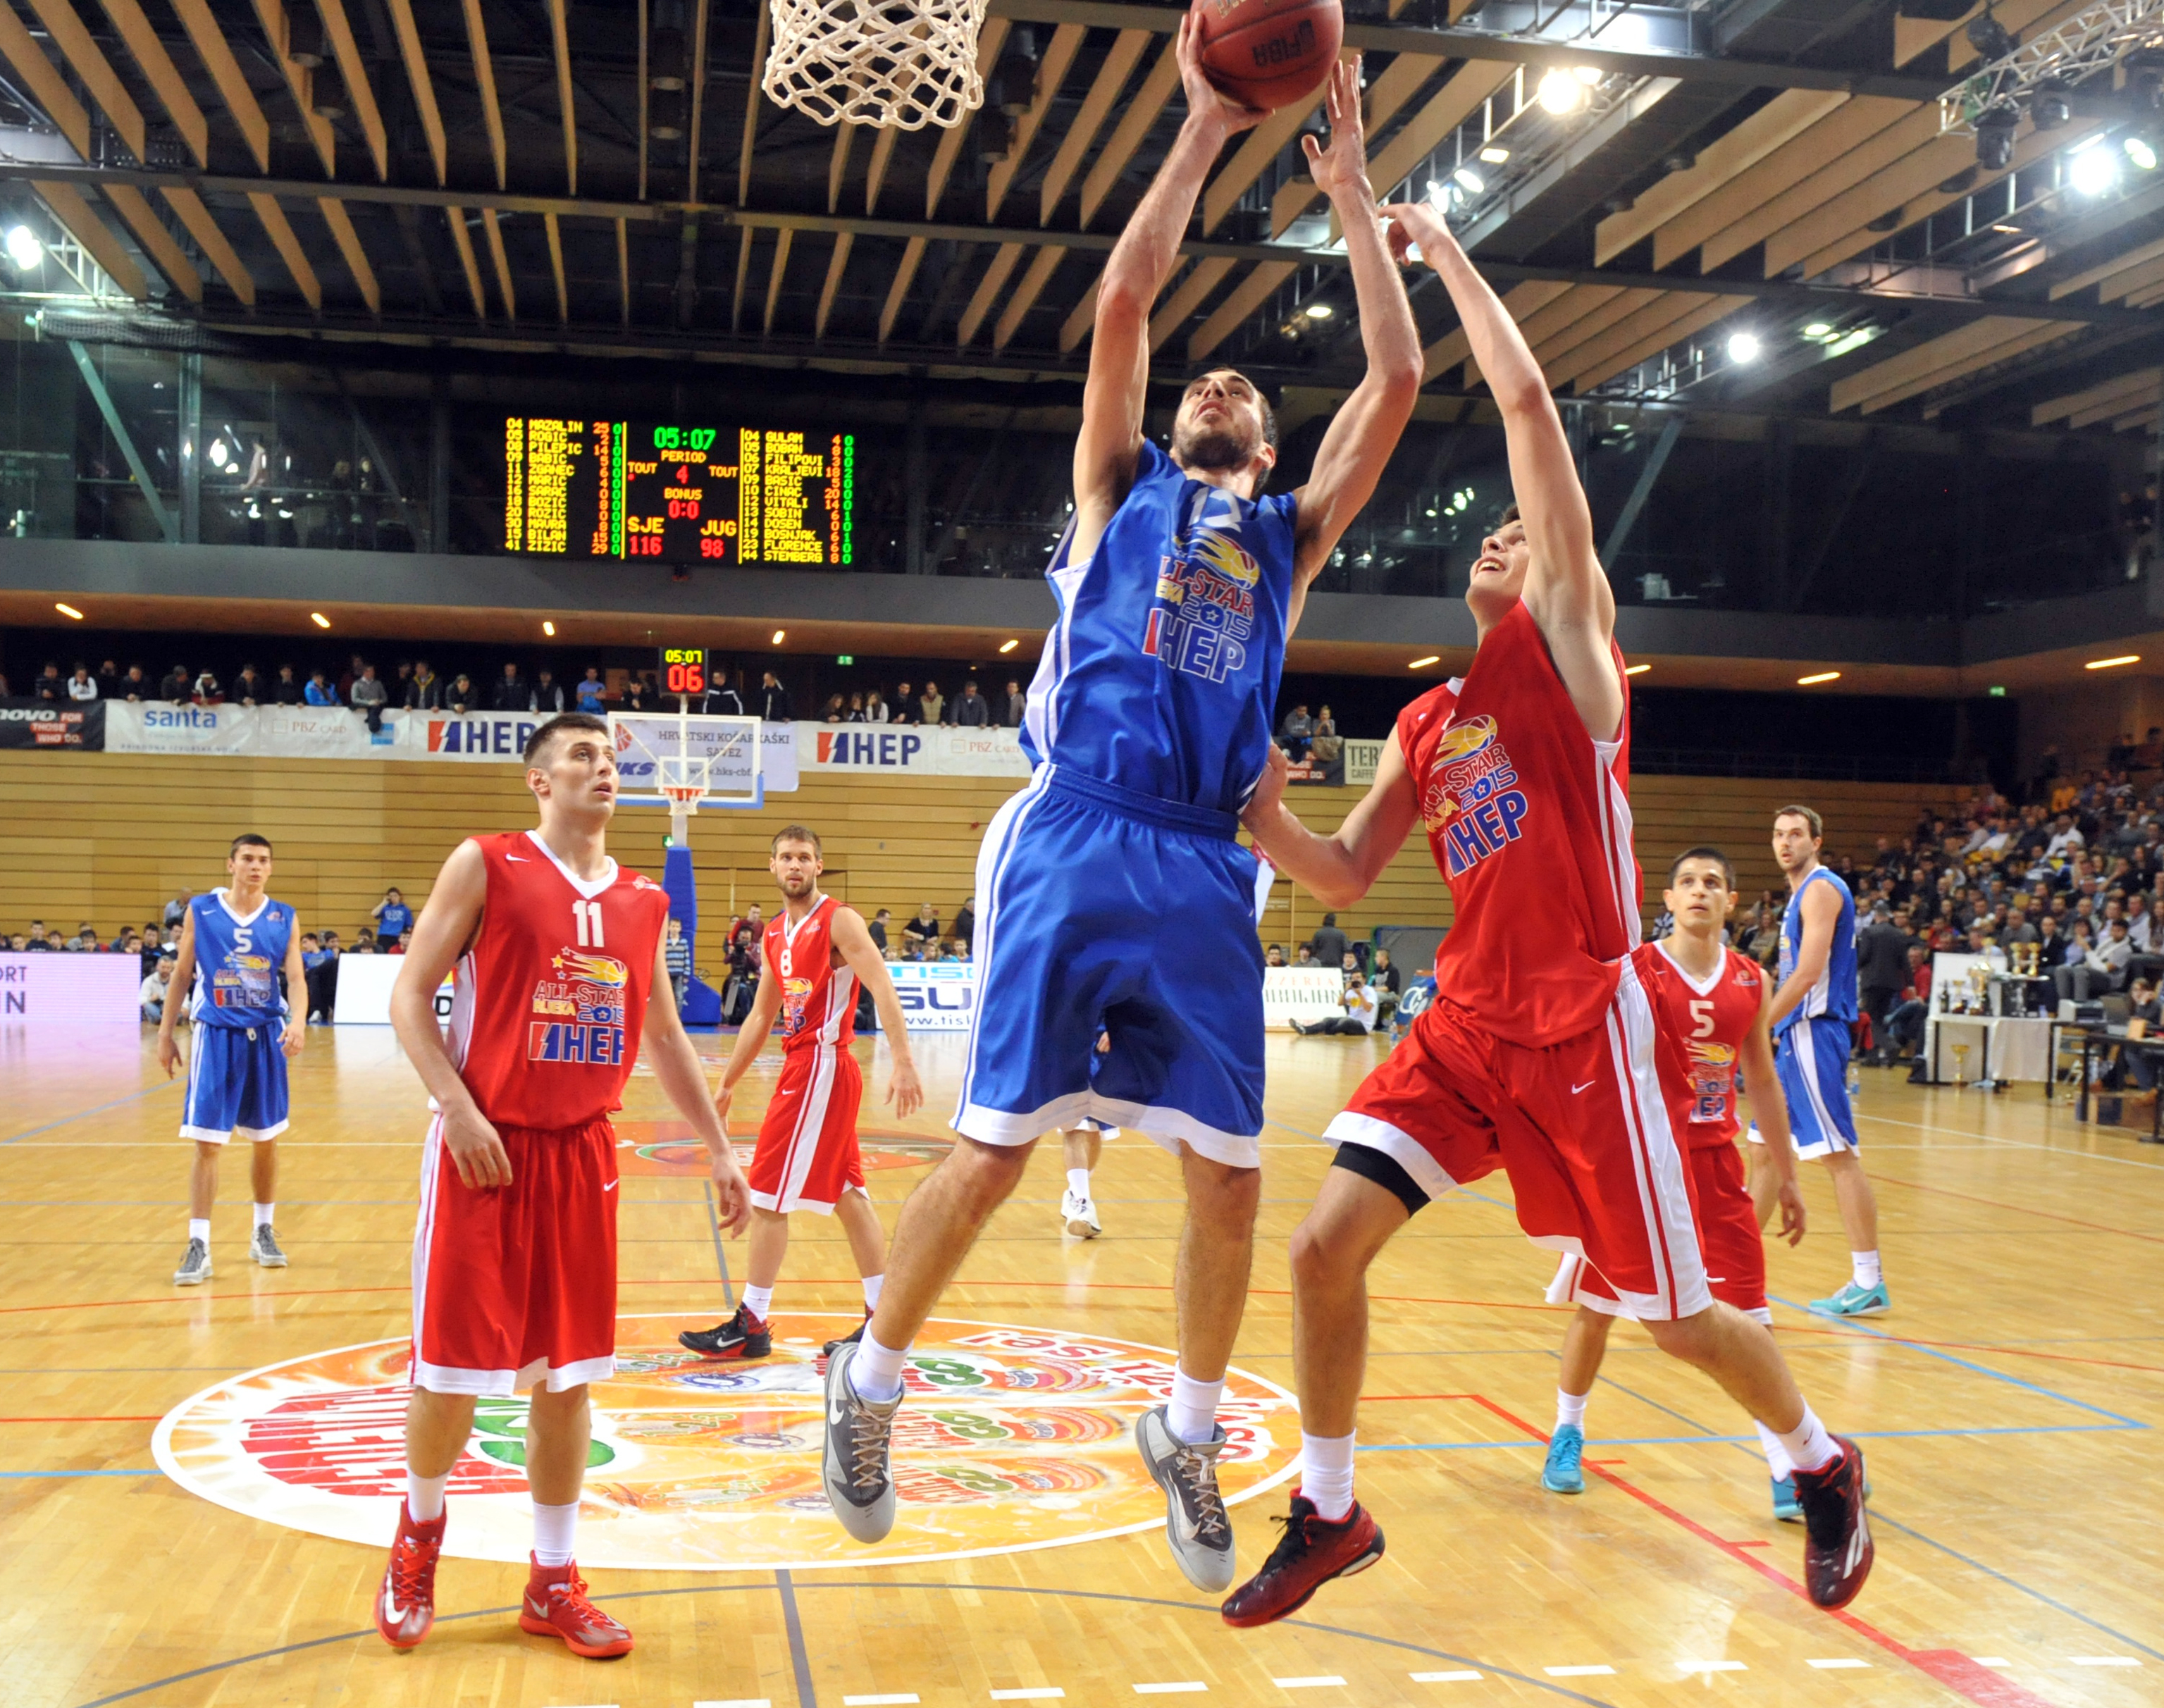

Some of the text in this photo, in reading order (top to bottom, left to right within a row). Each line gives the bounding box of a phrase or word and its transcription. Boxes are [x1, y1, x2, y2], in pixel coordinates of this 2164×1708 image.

[507, 418, 622, 435] 04 MAZALIN 25 0
[507, 429, 620, 445] 05 ROGIC 2 1
[654, 426, 716, 450] 05:07
[744, 431, 853, 445] 04 GULAM 4 0
[507, 440, 622, 457] 08 PILEPIC 14 0
[744, 441, 853, 457] 05 BOBAN 8 0
[507, 452, 622, 467] 09 BABIC 5 0
[661, 450, 707, 463] PERIOD
[744, 452, 853, 467] 06 FILIPOVI 3 0
[507, 462, 521, 473] 11
[600, 466, 609, 477] 6
[612, 467, 622, 478] 0
[628, 462, 657, 474] TOUT
[676, 464, 688, 484] 4
[708, 465, 738, 478] TOUT
[744, 463, 853, 478] 07 KRALJEVI 18 2
[507, 474, 621, 489] 12 MARIC 4 0
[744, 474, 853, 488] 09 BASIC 5 0
[507, 485, 522, 495] 16
[600, 488, 608, 499] 0
[612, 489, 621, 500] 0
[664, 488, 702, 500] BONUS
[744, 485, 852, 500] 10 CINAC 20 0
[507, 496, 621, 511] 18 BOZIC 8 0
[668, 500, 699, 519] 0:0
[744, 496, 852, 510] 12 VITALI 14 0
[506, 507, 621, 522] 20 ROZIC 0 0
[744, 507, 851, 521] 13 SOBIN 6 1
[506, 518, 522, 528] 30
[599, 521, 608, 532] 8
[612, 521, 621, 533] 0
[628, 516, 664, 533] SJE
[700, 519, 736, 536] JUG
[744, 518, 852, 532] 14 DOSEN 0 0
[507, 529, 620, 544] 15 BILAN 15 0
[744, 528, 850, 543] 19 BOSNJAK 6 1
[506, 540, 620, 555] 41 ZIZIC 29 0
[630, 536, 662, 555] 116
[700, 538, 724, 557] 98
[743, 540, 851, 553] 23 FLORENCE 6 0
[743, 550, 851, 564] 44 STEMBERG 8 0
[1159, 555, 1254, 619] LL-STAR
[665, 650, 702, 663] 05:07
[668, 664, 703, 693] 06
[144, 709, 218, 728] santa
[292, 721, 316, 733] PBZ
[659, 731, 715, 742] HRVTSKI
[706, 747, 742, 757] SAVEZ
[853, 733, 921, 766] HEP
[969, 742, 992, 753] PBZ
[1458, 762, 1519, 813] 2015
[1448, 790, 1528, 868] HEP
[572, 900, 605, 948] 11
[233, 928, 253, 953] 5
[781, 949, 792, 977] 8
[1690, 1000, 1715, 1037] 5
